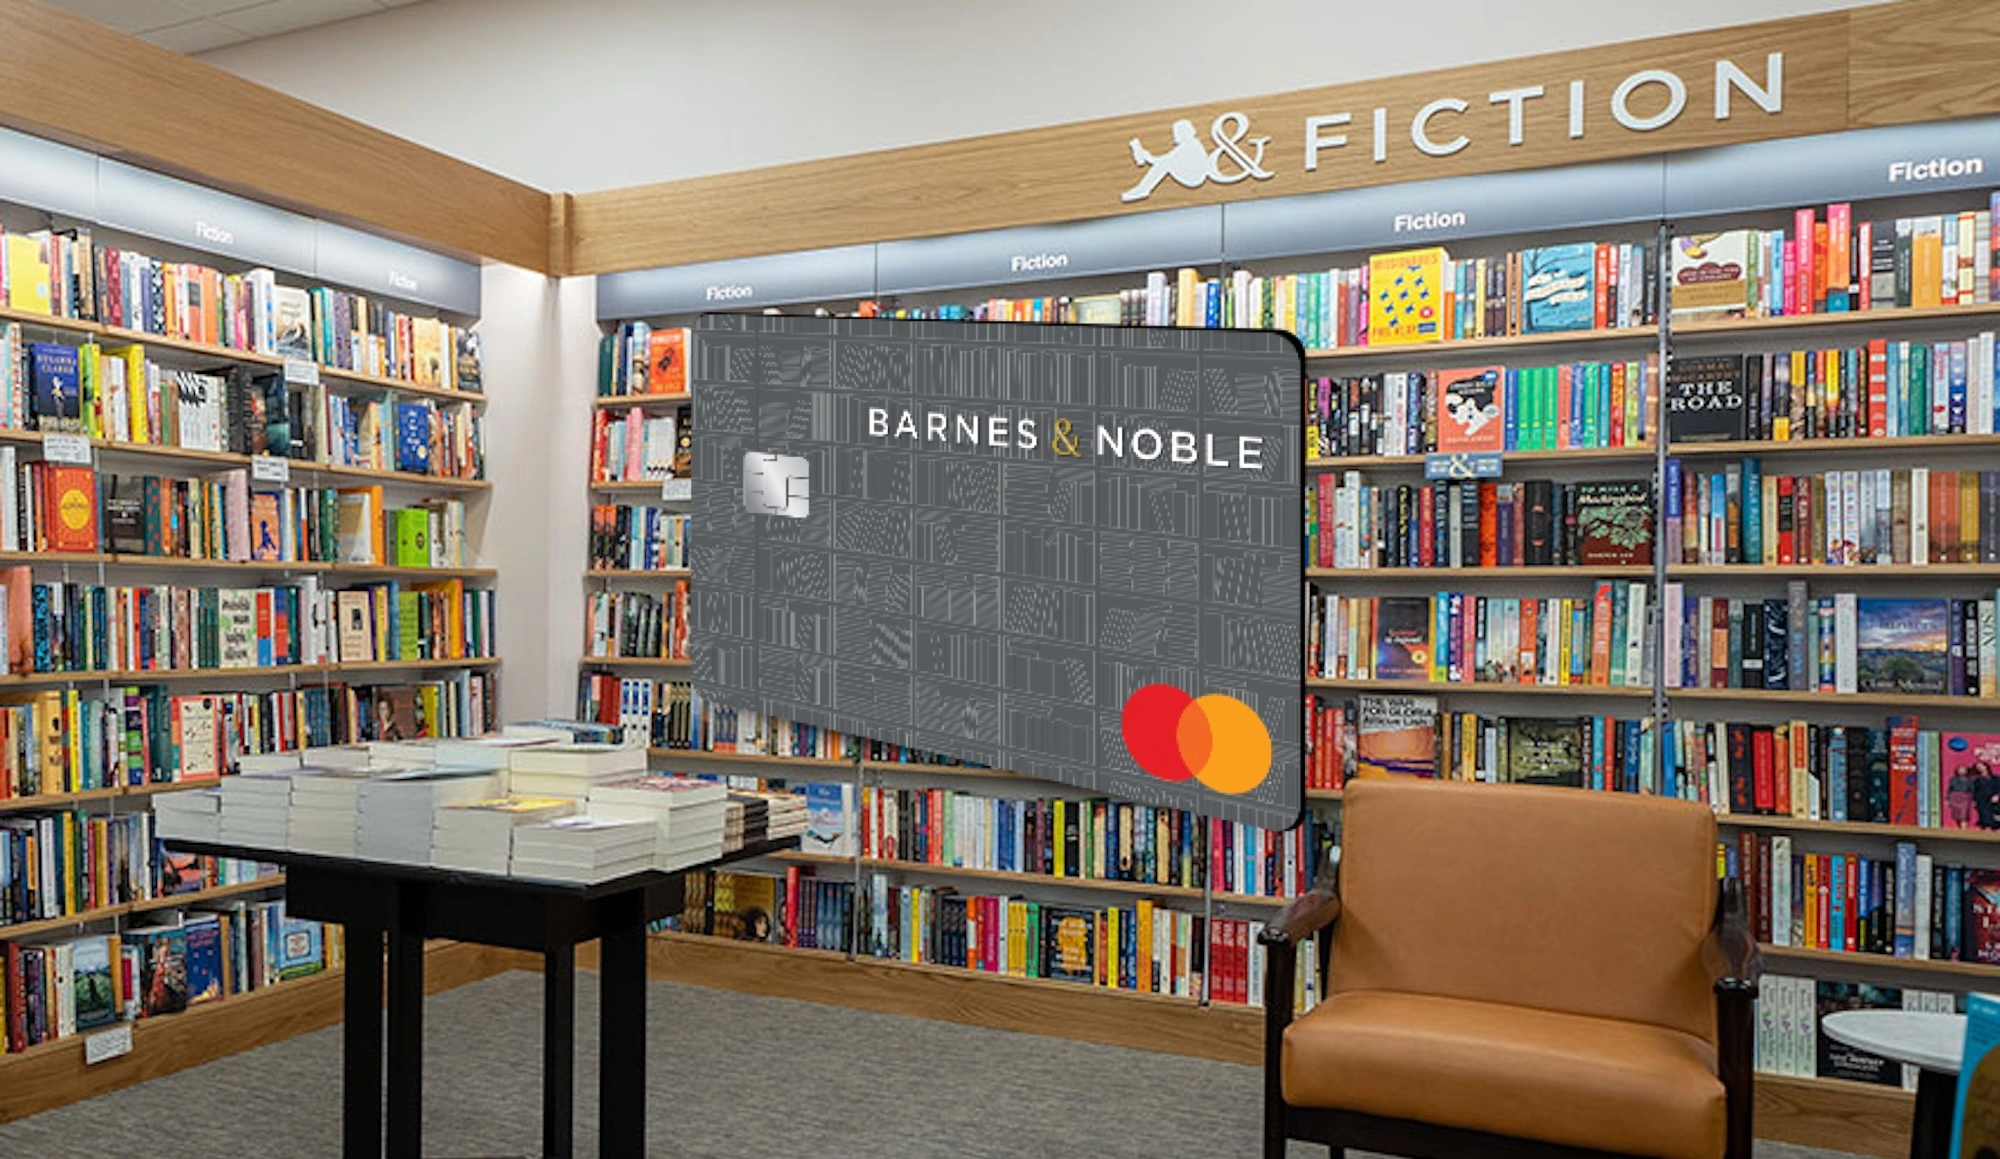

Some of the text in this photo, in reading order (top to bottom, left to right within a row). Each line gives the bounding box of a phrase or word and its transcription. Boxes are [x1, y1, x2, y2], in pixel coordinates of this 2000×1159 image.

[1304, 51, 1783, 171] FICTION
[1889, 157, 1984, 183] Fiction
[1393, 211, 1467, 233] Fiction
[1011, 252, 1069, 273] Fiction
[705, 284, 753, 301] Fiction
[1678, 380, 1733, 397] THE
[1670, 394, 1742, 412] ROAD
